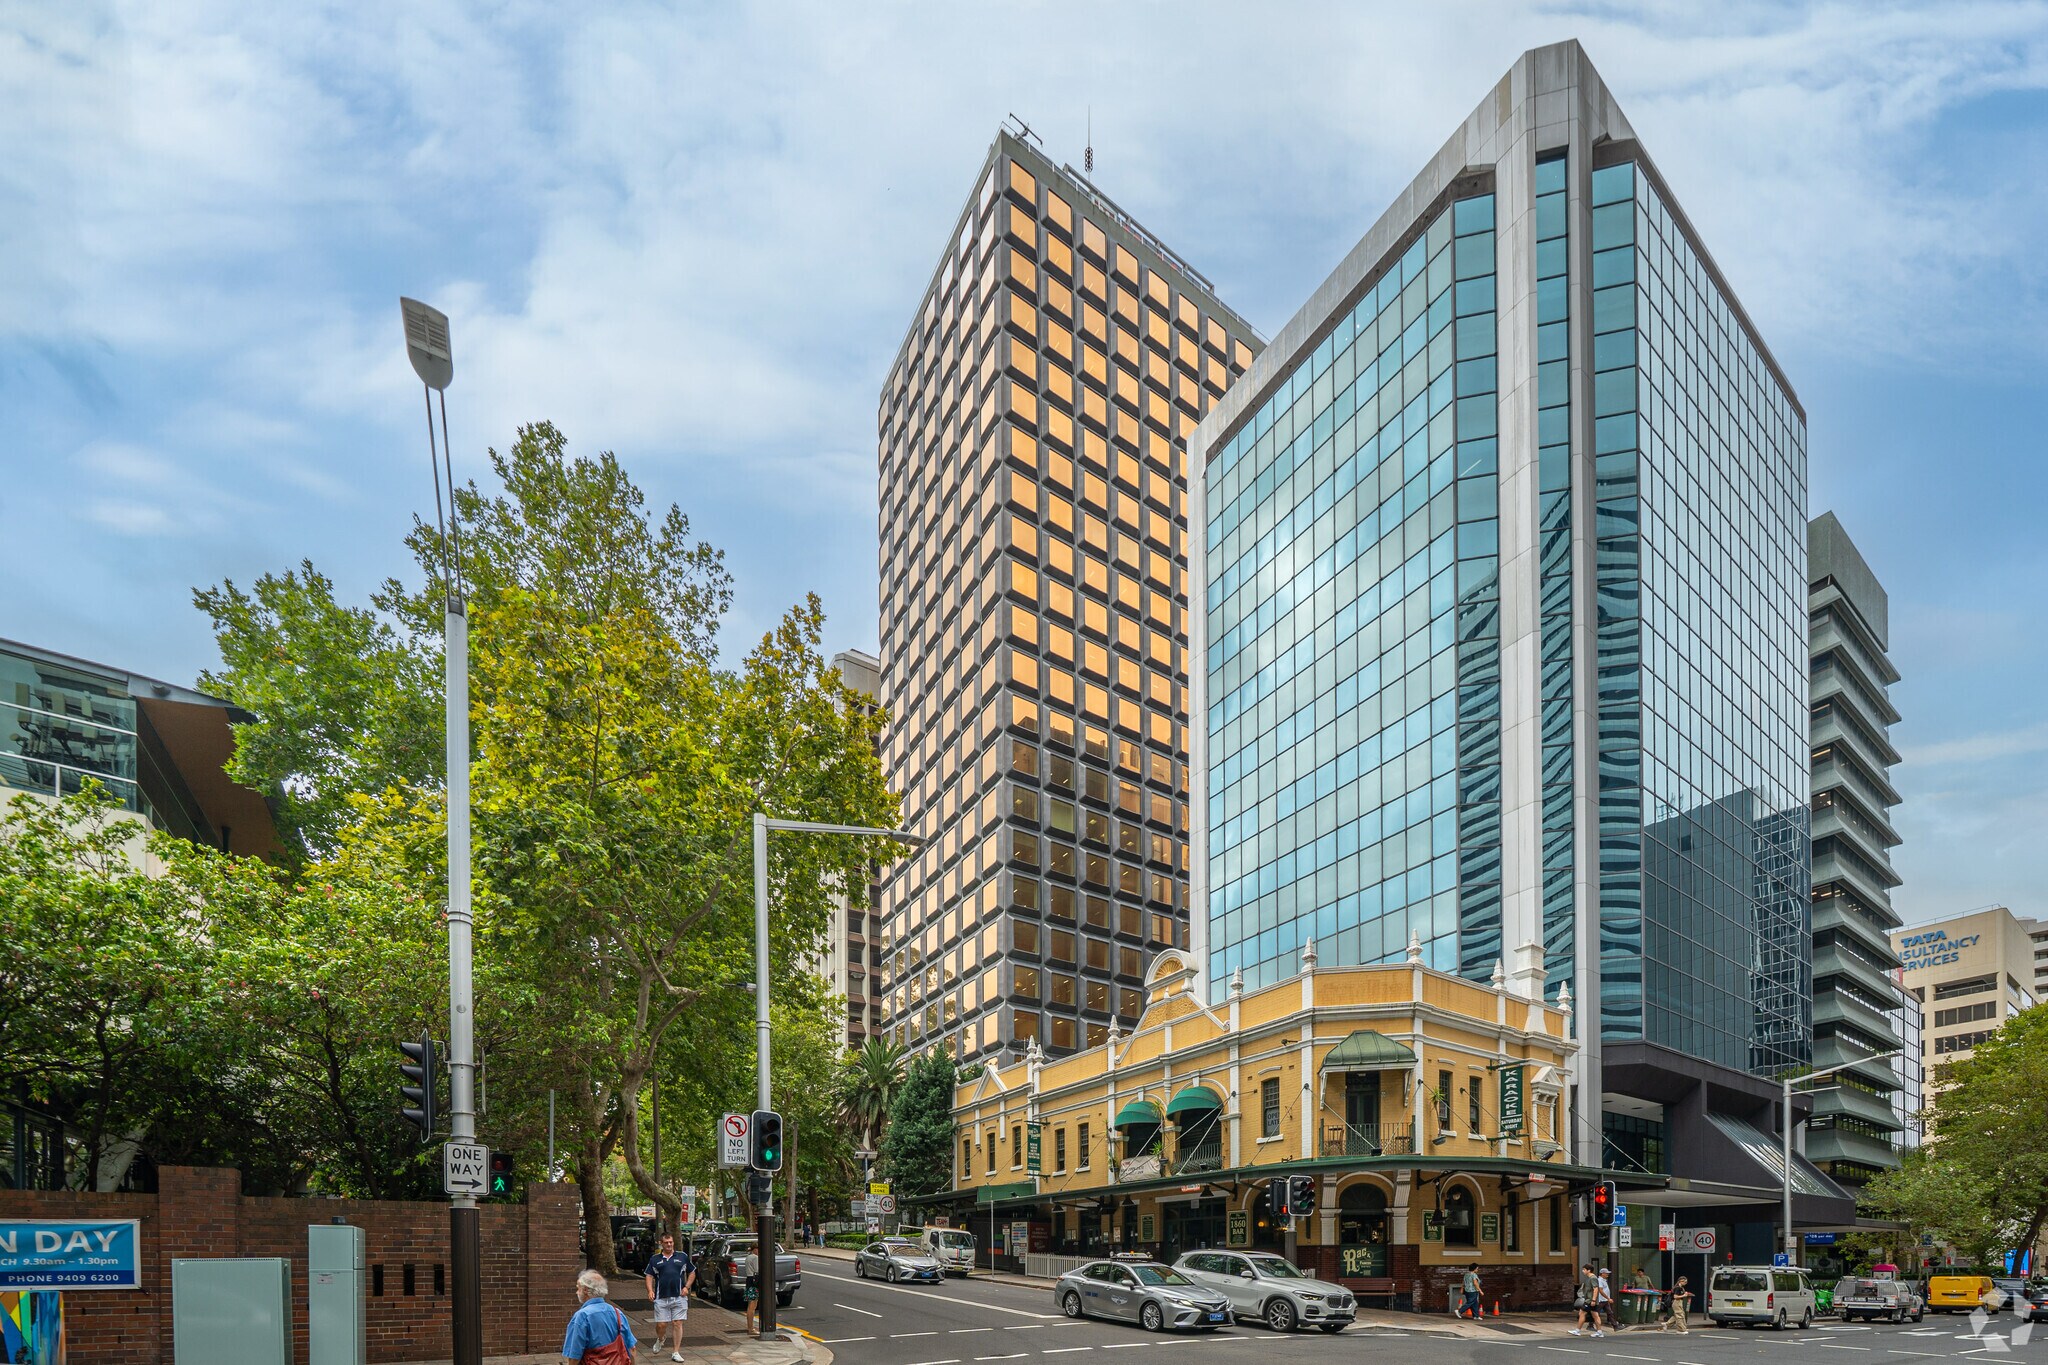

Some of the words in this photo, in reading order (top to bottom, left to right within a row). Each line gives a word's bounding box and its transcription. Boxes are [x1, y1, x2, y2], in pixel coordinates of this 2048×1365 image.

[1901, 930, 1947, 948] TATA
[1902, 951, 1959, 972] ERVICES
[1503, 1070, 1519, 1115] KARAOKE
[729, 1139, 743, 1147] NO
[452, 1148, 481, 1160] ONE
[450, 1163, 483, 1175] WAY
[882, 1200, 893, 1208] 40
[1230, 1220, 1246, 1228] 1860
[35, 1231, 118, 1253] DAY
[1698, 1236, 1712, 1244] 40
[23, 1258, 66, 1266] 9.30am
[79, 1257, 119, 1266] 1.30pm
[57, 1274, 86, 1282] 9409
